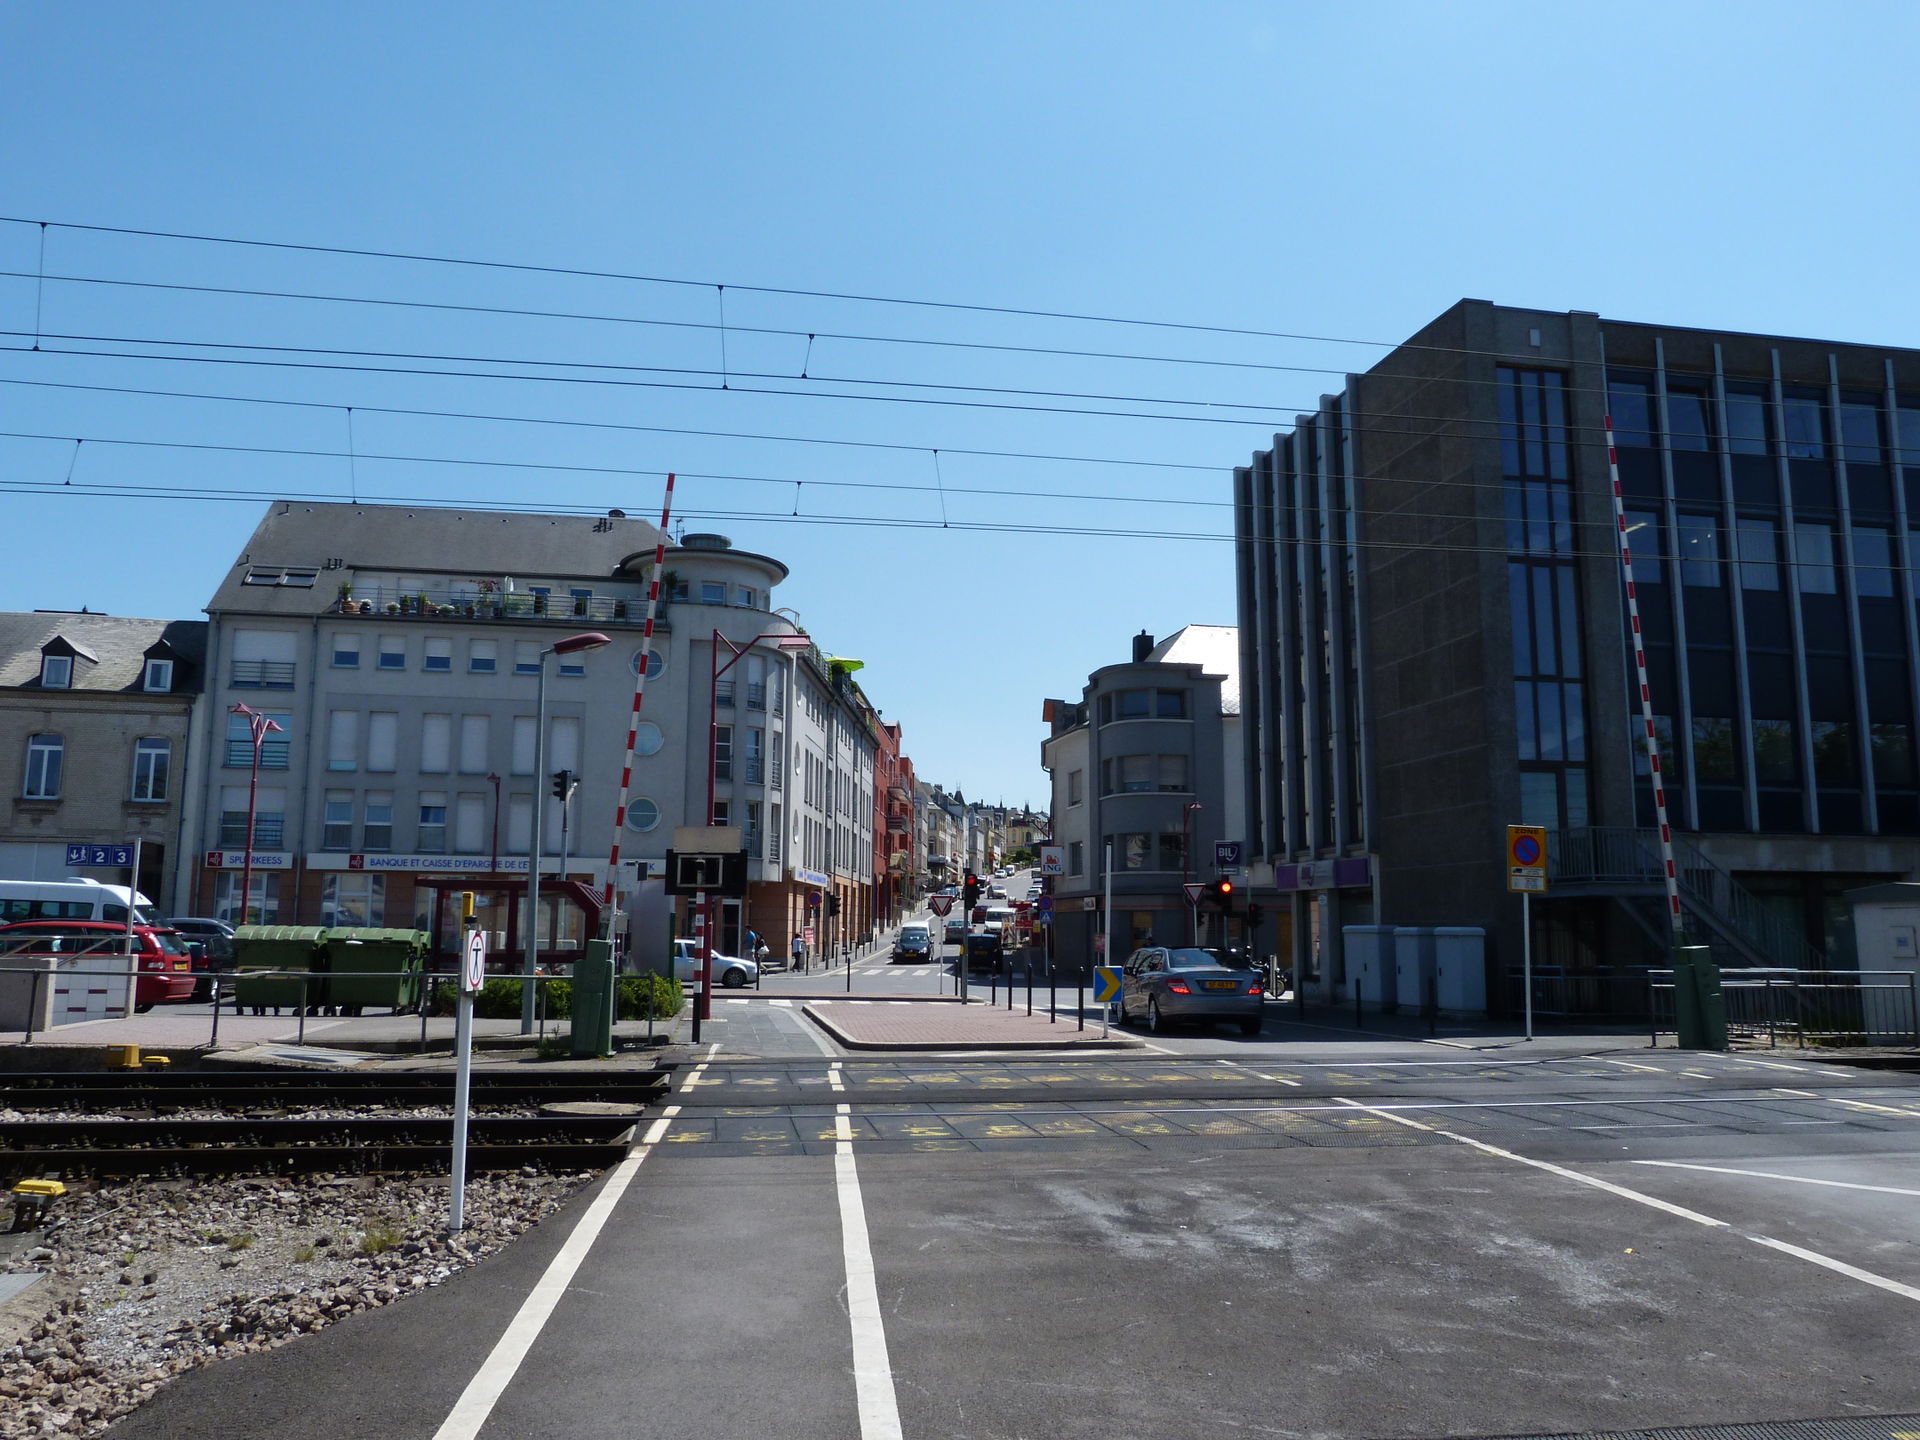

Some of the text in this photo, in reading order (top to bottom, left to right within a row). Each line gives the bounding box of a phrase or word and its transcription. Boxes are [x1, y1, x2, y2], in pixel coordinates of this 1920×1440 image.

[95, 851, 126, 863] 2 3
[1218, 847, 1233, 857] BIL
[229, 855, 282, 865] SPURKEESS
[370, 858, 409, 867] BANQUE
[410, 858, 419, 867] ET
[422, 859, 452, 868] CAISSE
[504, 860, 517, 869] DE
[1043, 864, 1061, 872] ING
